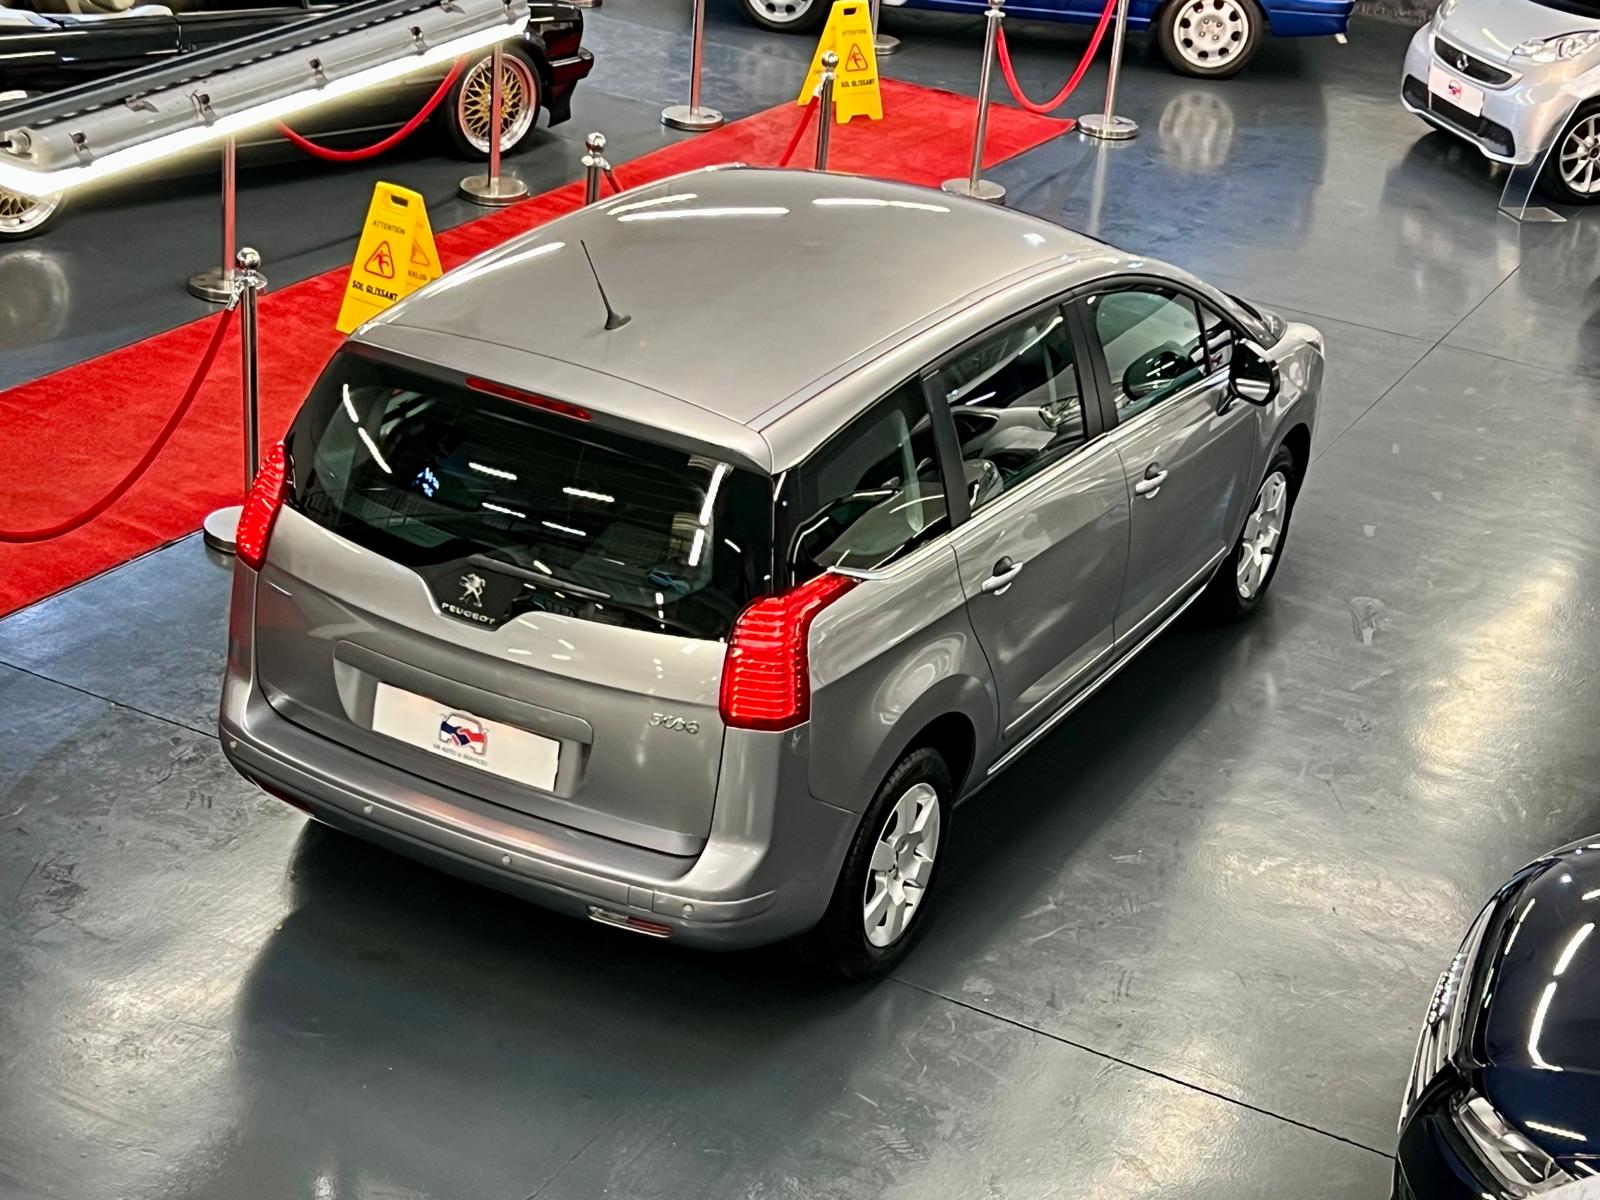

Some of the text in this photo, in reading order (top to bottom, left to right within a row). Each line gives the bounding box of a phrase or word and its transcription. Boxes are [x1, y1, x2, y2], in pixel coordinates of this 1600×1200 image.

[372, 219, 406, 235] ATTENTION
[352, 280, 398, 302] SOL GLISSANT
[441, 602, 496, 625] PEUGEOT
